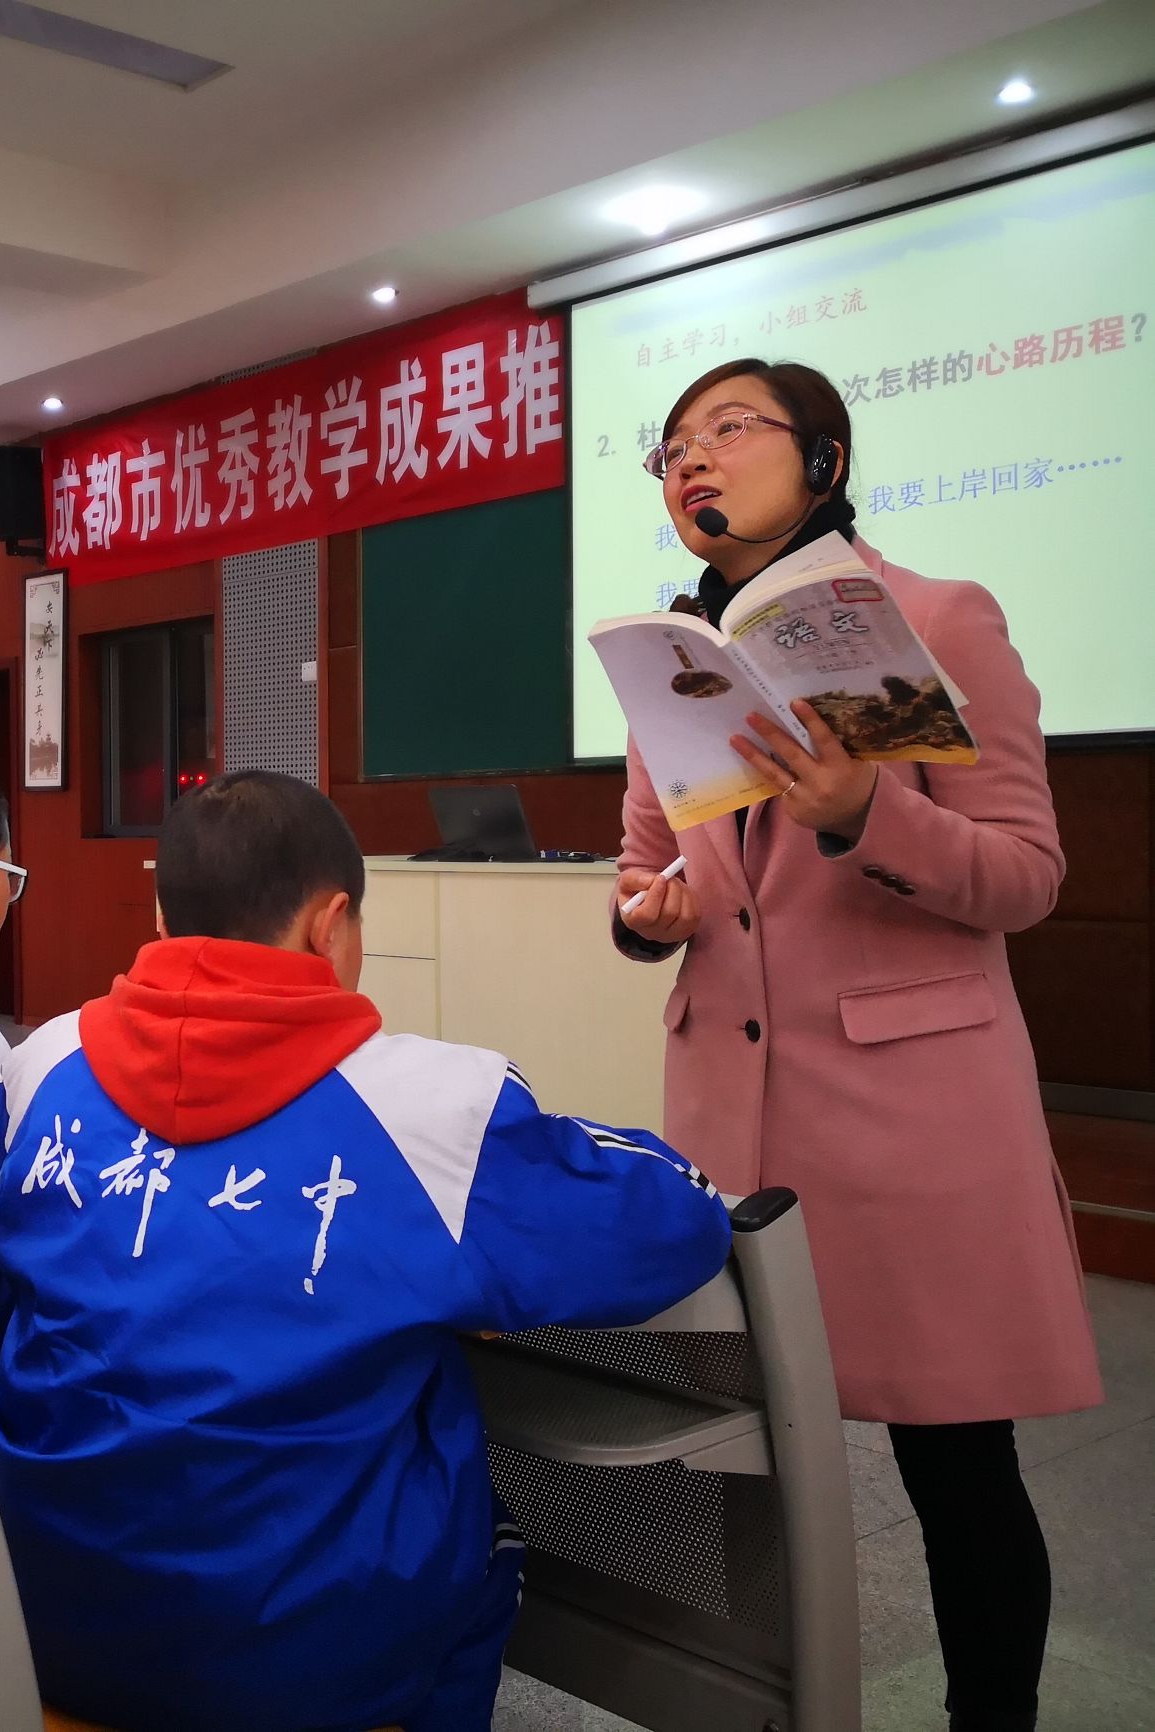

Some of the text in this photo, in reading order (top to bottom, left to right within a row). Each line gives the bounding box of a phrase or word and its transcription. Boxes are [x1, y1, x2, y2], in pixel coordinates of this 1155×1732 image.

[637, 287, 867, 368] 自主学习，小组交流
[48, 321, 563, 558] 成都市优秀教学成果推
[21, 1114, 357, 1296] 成都七中
